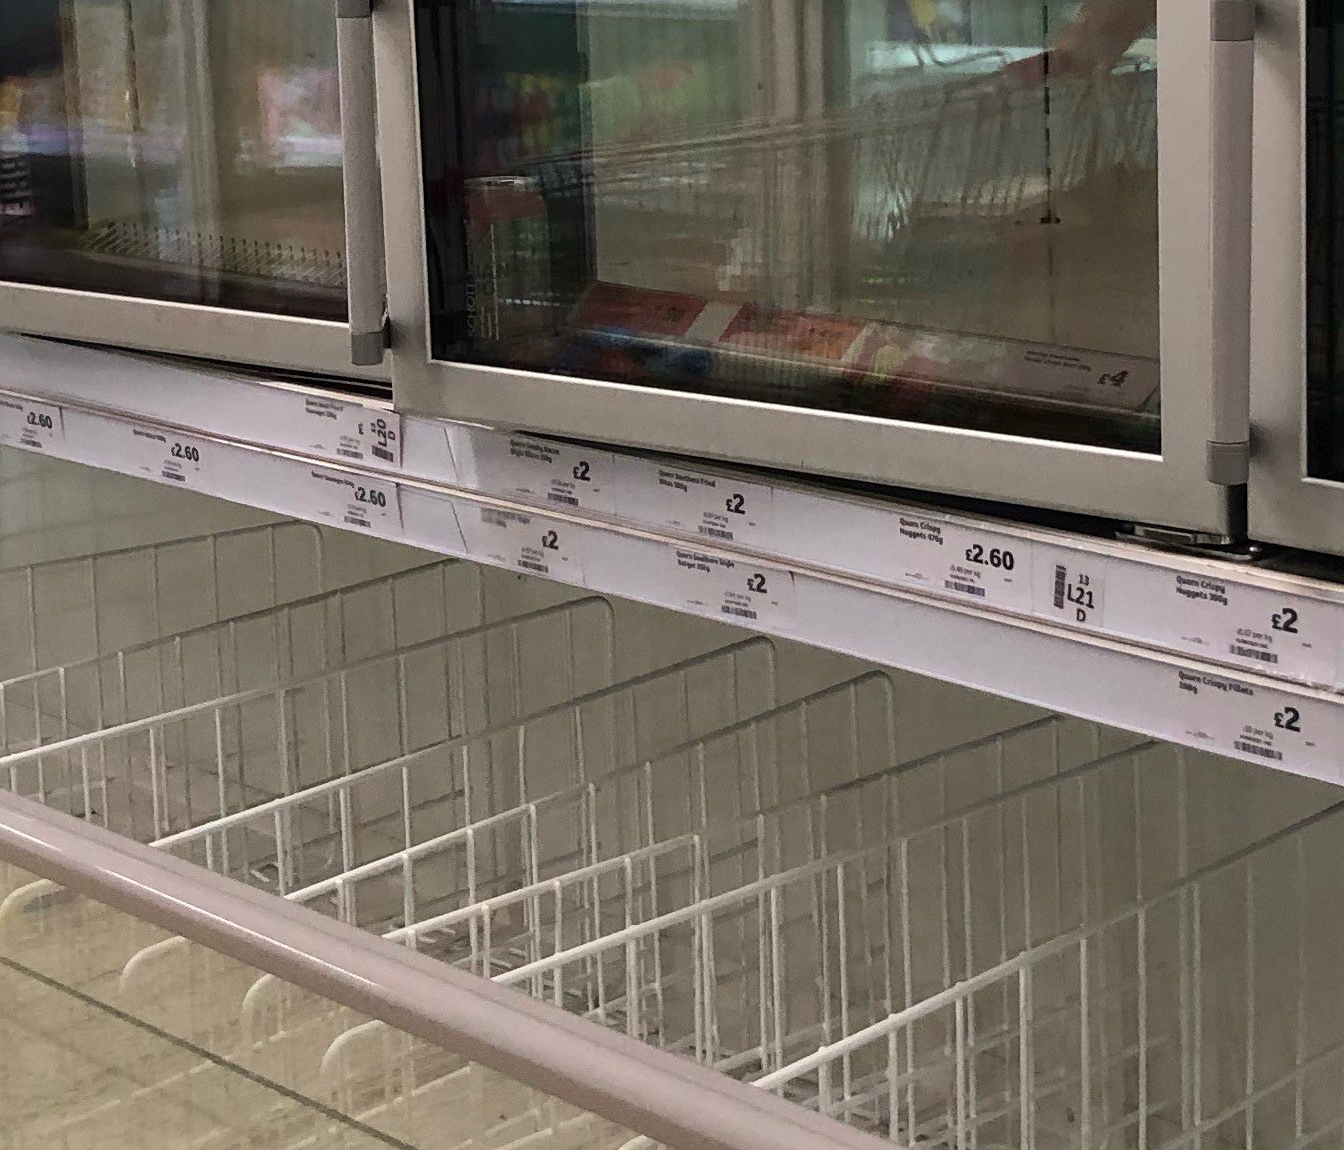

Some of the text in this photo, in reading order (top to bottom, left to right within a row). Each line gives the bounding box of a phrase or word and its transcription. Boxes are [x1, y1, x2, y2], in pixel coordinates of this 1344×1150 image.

[171, 442, 200, 462] £2.60
[573, 461, 591, 482] £2
[354, 486, 386, 507] £2.60
[725, 493, 745, 515] £2
[542, 530, 559, 550] £2
[965, 543, 1014, 570] £2.60
[747, 573, 768, 594] £2
[1079, 574, 1089, 586] 13
[1176, 575, 1225, 594] Quorn Crispy
[1067, 583, 1095, 610] L21
[1176, 586, 1207, 600] Nuggets
[1076, 608, 1087, 622] D
[1271, 607, 1298, 634] £2
[1202, 676, 1227, 691] Crispy
[1274, 707, 1301, 733] £2
